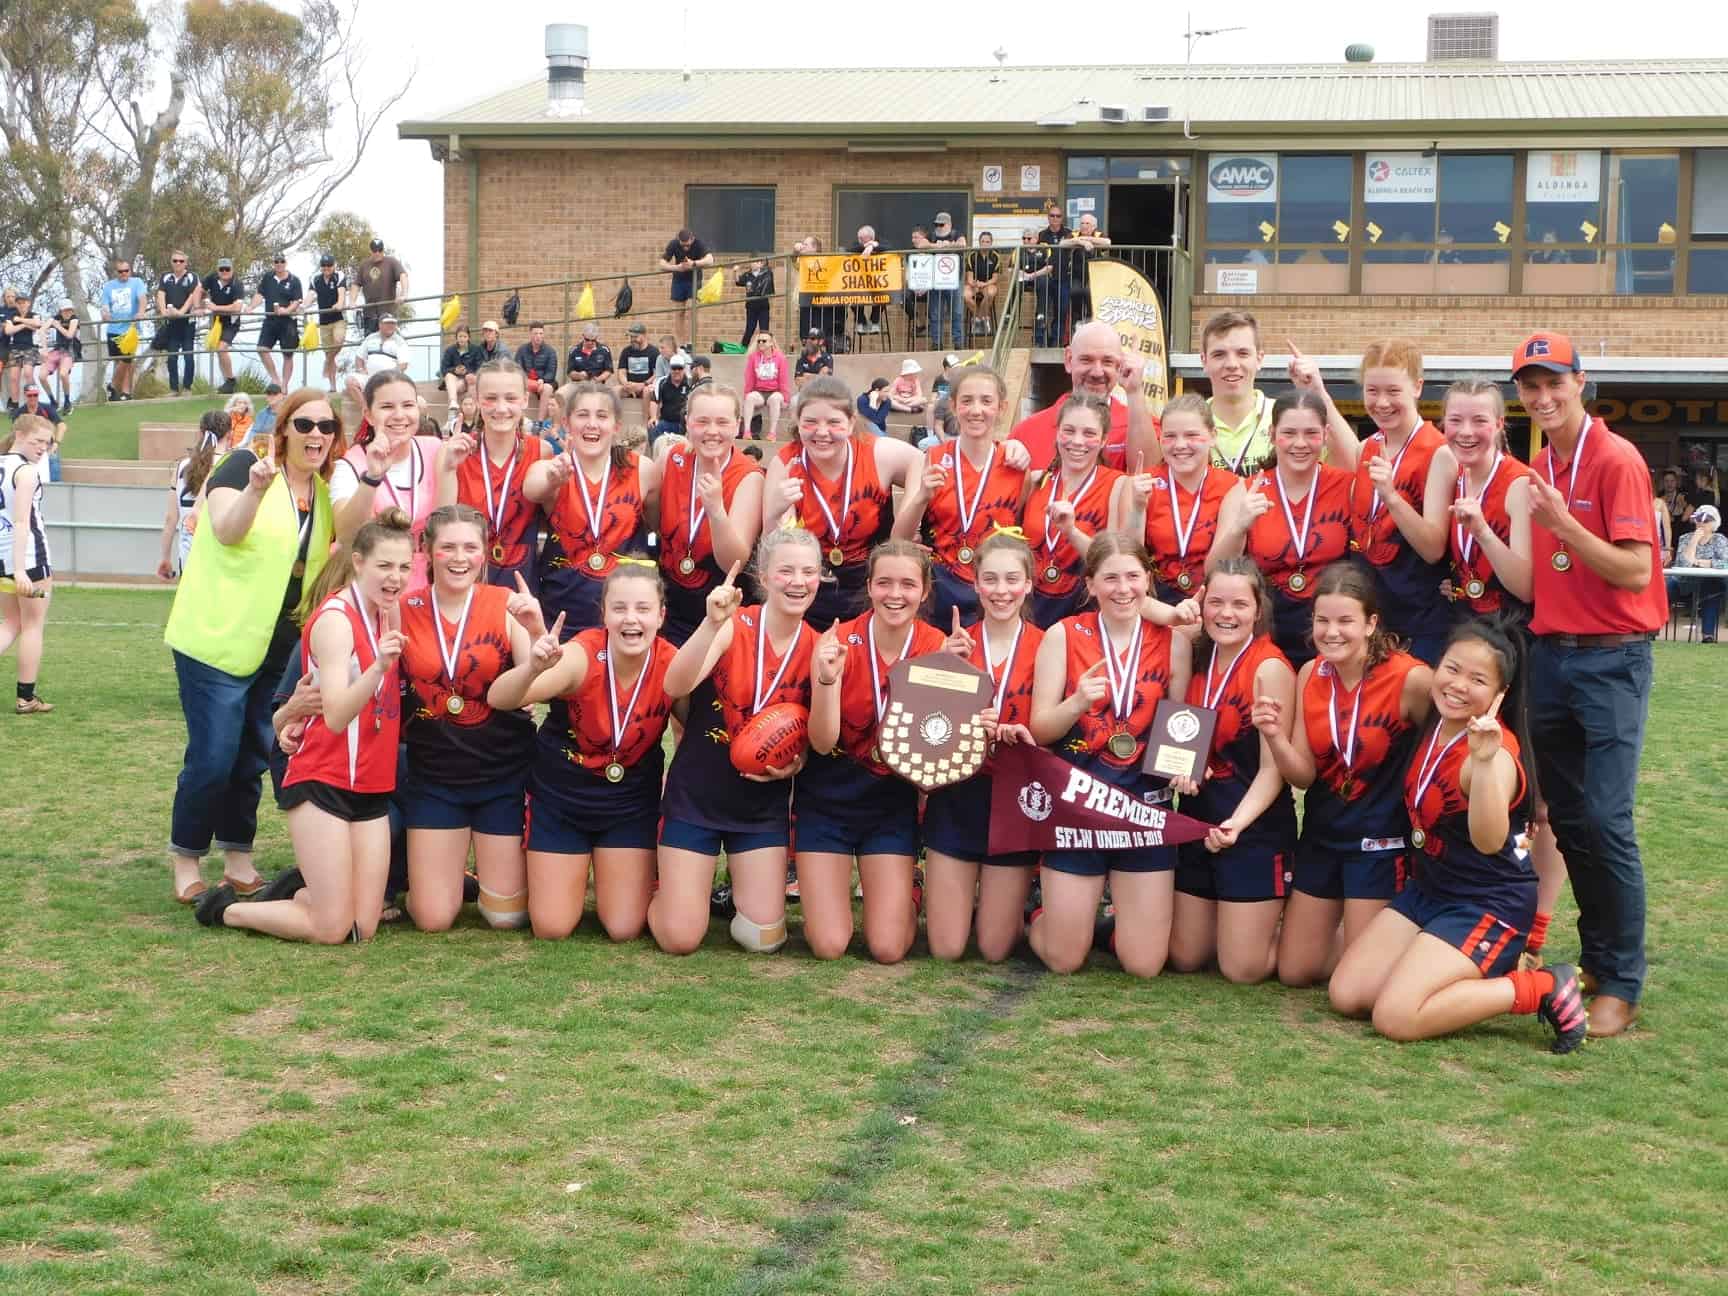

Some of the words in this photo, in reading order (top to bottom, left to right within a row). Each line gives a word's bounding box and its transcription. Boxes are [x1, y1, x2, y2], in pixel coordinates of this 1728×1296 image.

[1218, 167, 1270, 184] AMAC
[1394, 167, 1432, 176] CALTEX
[1537, 180, 1588, 189] ALDINGA
[843, 258, 860, 273] GO
[863, 258, 887, 272] THE
[842, 275, 888, 289] SHARKS
[840, 295, 873, 304] FOOTBALL
[874, 295, 889, 304] CLUB
[1060, 767, 1167, 829] PREMIERS
[1055, 826, 1093, 848] SFLW
[1095, 829, 1132, 848] UNDER
[1132, 831, 1143, 847] 16
